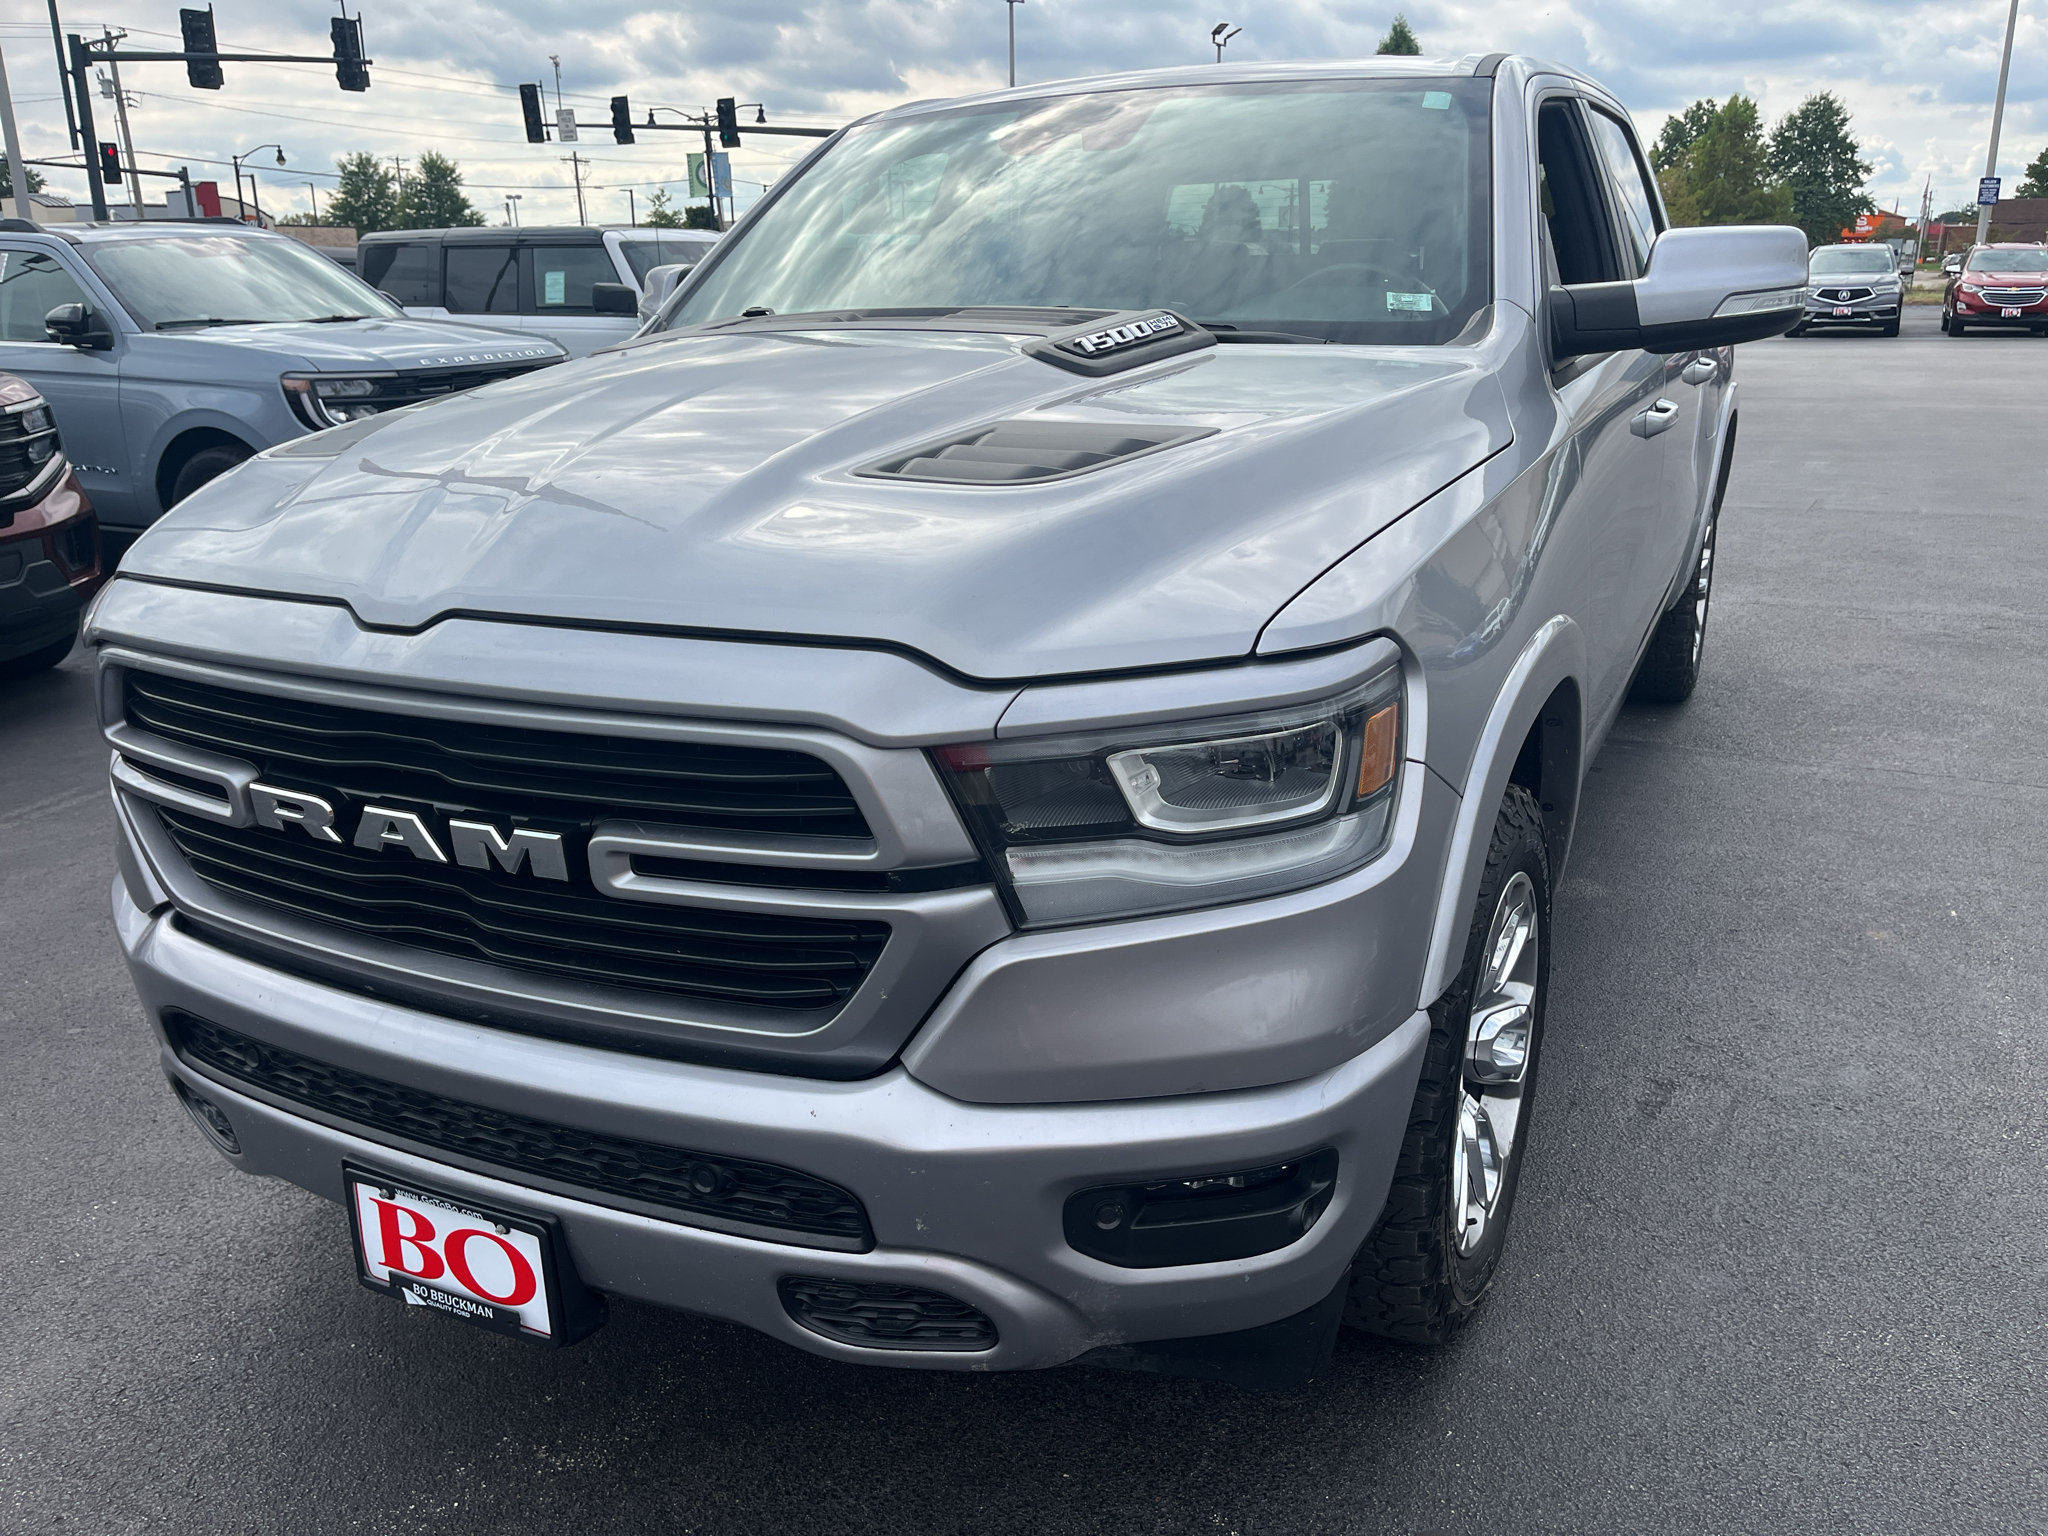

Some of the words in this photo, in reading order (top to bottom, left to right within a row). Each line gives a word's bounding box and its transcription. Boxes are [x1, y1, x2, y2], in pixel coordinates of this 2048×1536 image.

[1150, 315, 1173, 326] HEMI
[1074, 321, 1153, 353] 1500
[419, 348, 546, 366] EXPEDITION
[249, 782, 569, 882] RAM
[368, 1196, 537, 1306] BO
[412, 1282, 429, 1298] BO
[430, 1288, 494, 1319] BEUCKMAN
[426, 1299, 453, 1312] QUALITY
[453, 1307, 471, 1318] FORD
